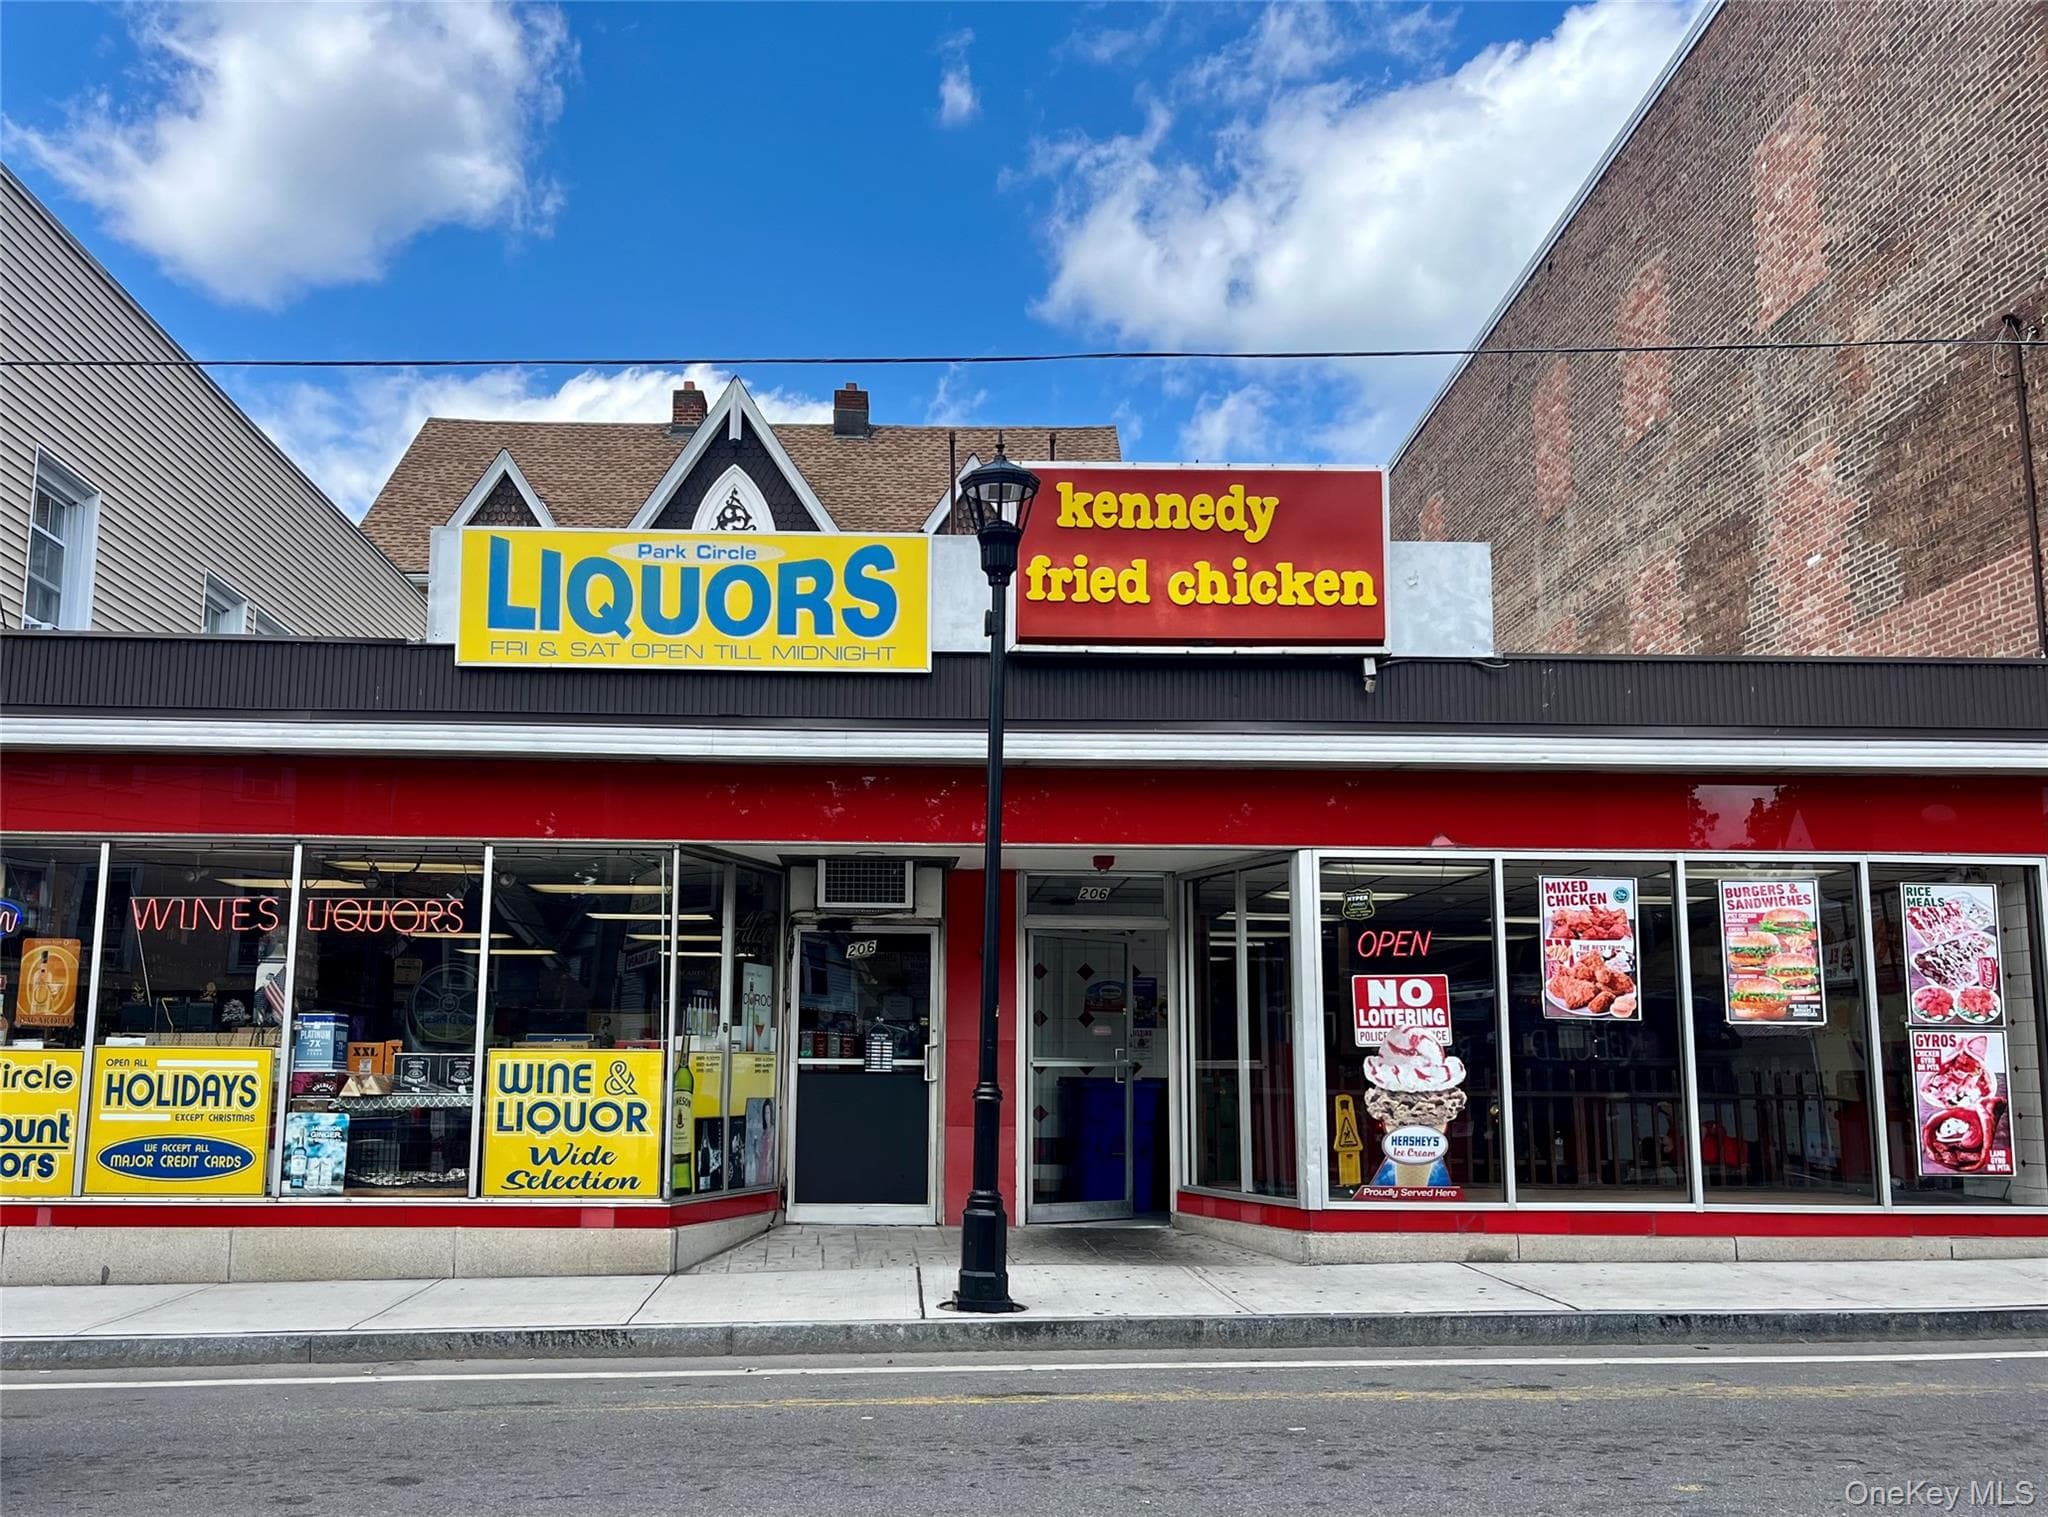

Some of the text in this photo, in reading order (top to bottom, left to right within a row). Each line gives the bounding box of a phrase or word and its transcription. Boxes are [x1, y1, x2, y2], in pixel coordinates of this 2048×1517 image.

[1056, 482, 1279, 543] kennedy
[638, 544, 757, 561] Park Circle
[487, 535, 898, 640] LIQUORS
[1026, 555, 1377, 606] fried chicken
[490, 641, 896, 661] FRI & SAT OPEN TILL MIDNIGHT
[1079, 888, 1108, 900] 206
[1545, 880, 1588, 894] MIXED
[1725, 883, 1798, 899] BURGERS &
[1906, 887, 1931, 897] RICE
[1547, 892, 1607, 907] CHICKEN
[1727, 894, 1812, 911] SANDWICHES
[1907, 897, 1945, 908] MEALS
[131, 898, 279, 932] WINES
[306, 899, 465, 933] LIQUORS
[848, 942, 875, 957] 206
[1357, 930, 1432, 958] OPEN
[1367, 978, 1433, 1007] NO
[1358, 1008, 1446, 1027] LOITERING
[300, 1030, 331, 1040] PLATINUM
[1915, 1034, 1956, 1048] GYROS
[353, 1046, 379, 1057] XXL
[106, 1059, 149, 1067] OPEN ALL
[0, 1063, 74, 1089] ircle
[498, 1062, 593, 1095] WINE
[604, 1060, 637, 1096] &
[104, 1073, 258, 1107] HOLIDAYS
[175, 1113, 256, 1123] EXCEPT CHRISTMAS
[496, 1101, 648, 1135] LIQUOR
[144, 1144, 210, 1153] WE ACCEPT ALL
[1391, 1136, 1440, 1147] HERSHEY'S
[528, 1143, 617, 1167] Wide
[1393, 1148, 1436, 1157] Ice Cream
[110, 1155, 242, 1168] MAJOR CREDIT CARDS
[500, 1169, 642, 1191] Selection
[1363, 1187, 1457, 1198] Proudly Served Here
